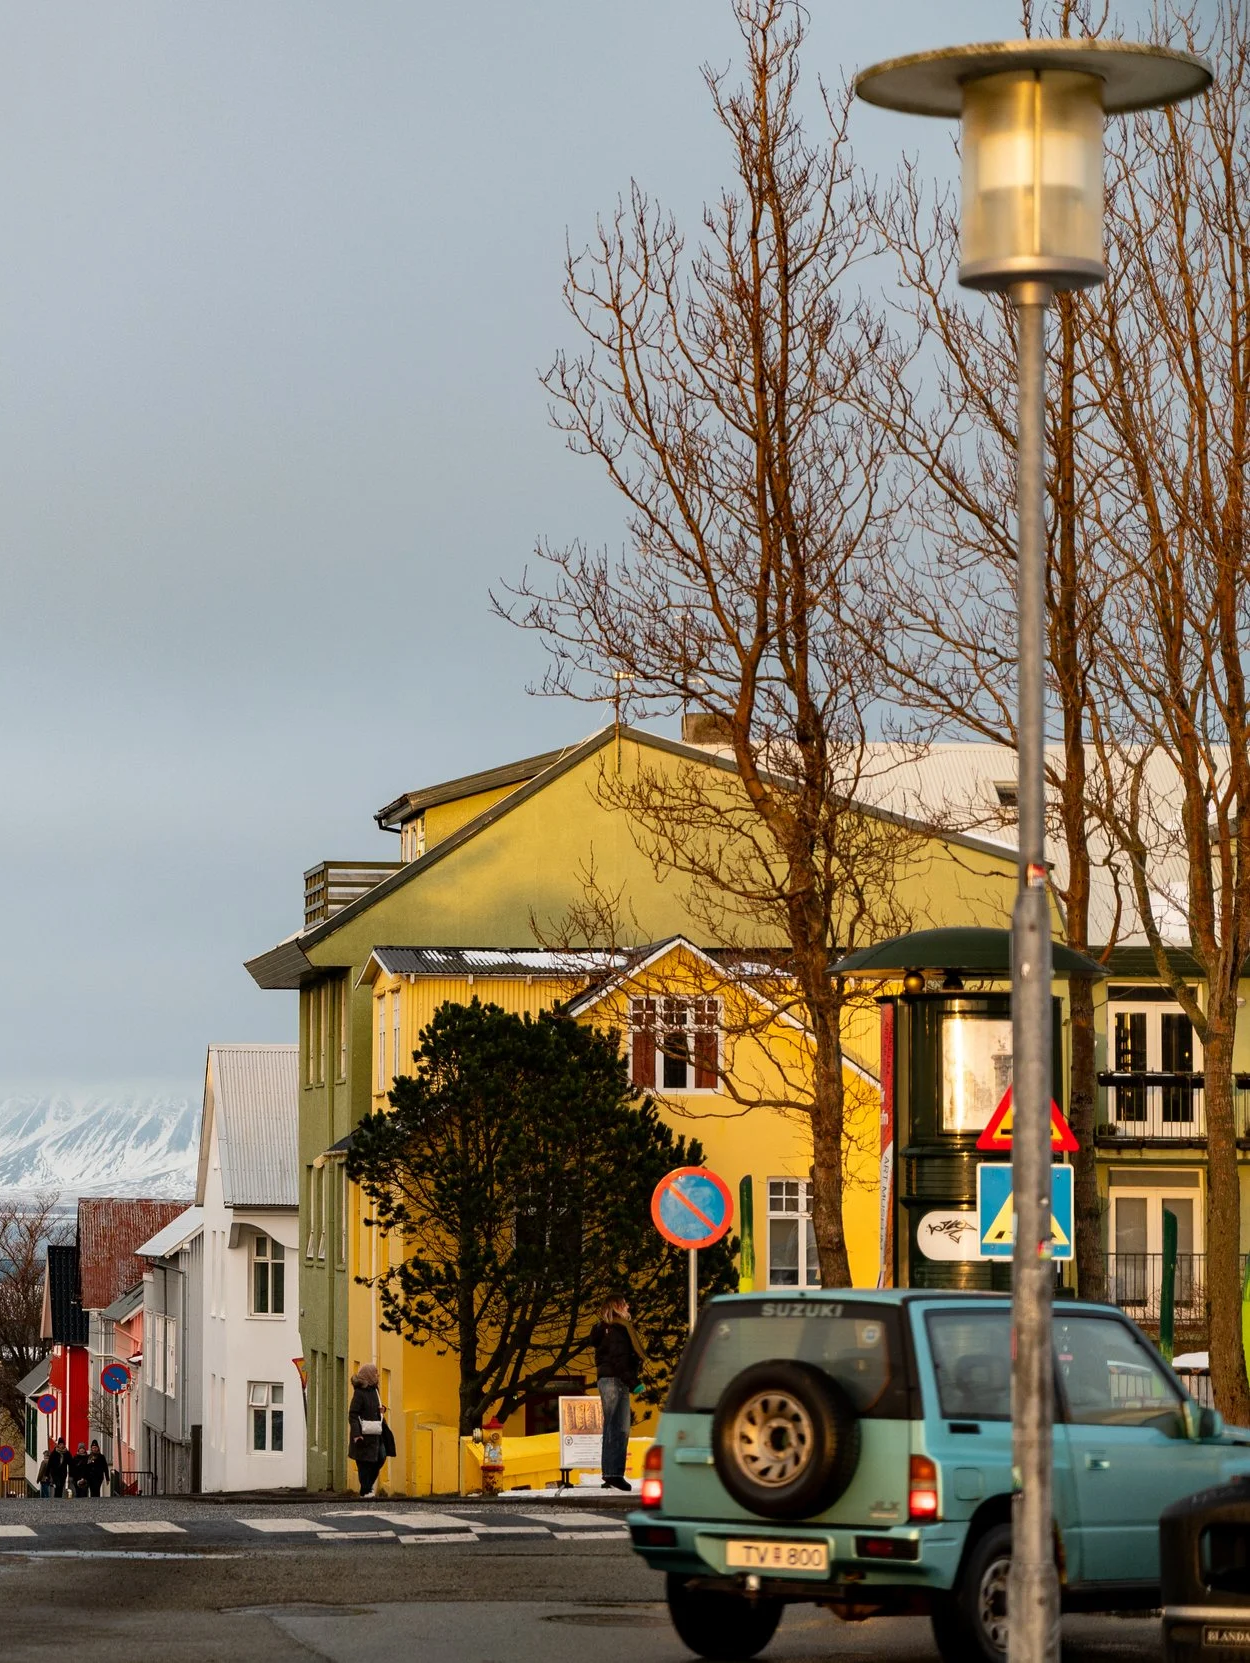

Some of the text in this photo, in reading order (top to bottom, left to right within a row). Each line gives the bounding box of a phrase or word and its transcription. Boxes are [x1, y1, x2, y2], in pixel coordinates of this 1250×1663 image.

[761, 1303, 844, 1318] SUZUKI
[742, 1544, 823, 1567] TV 800
